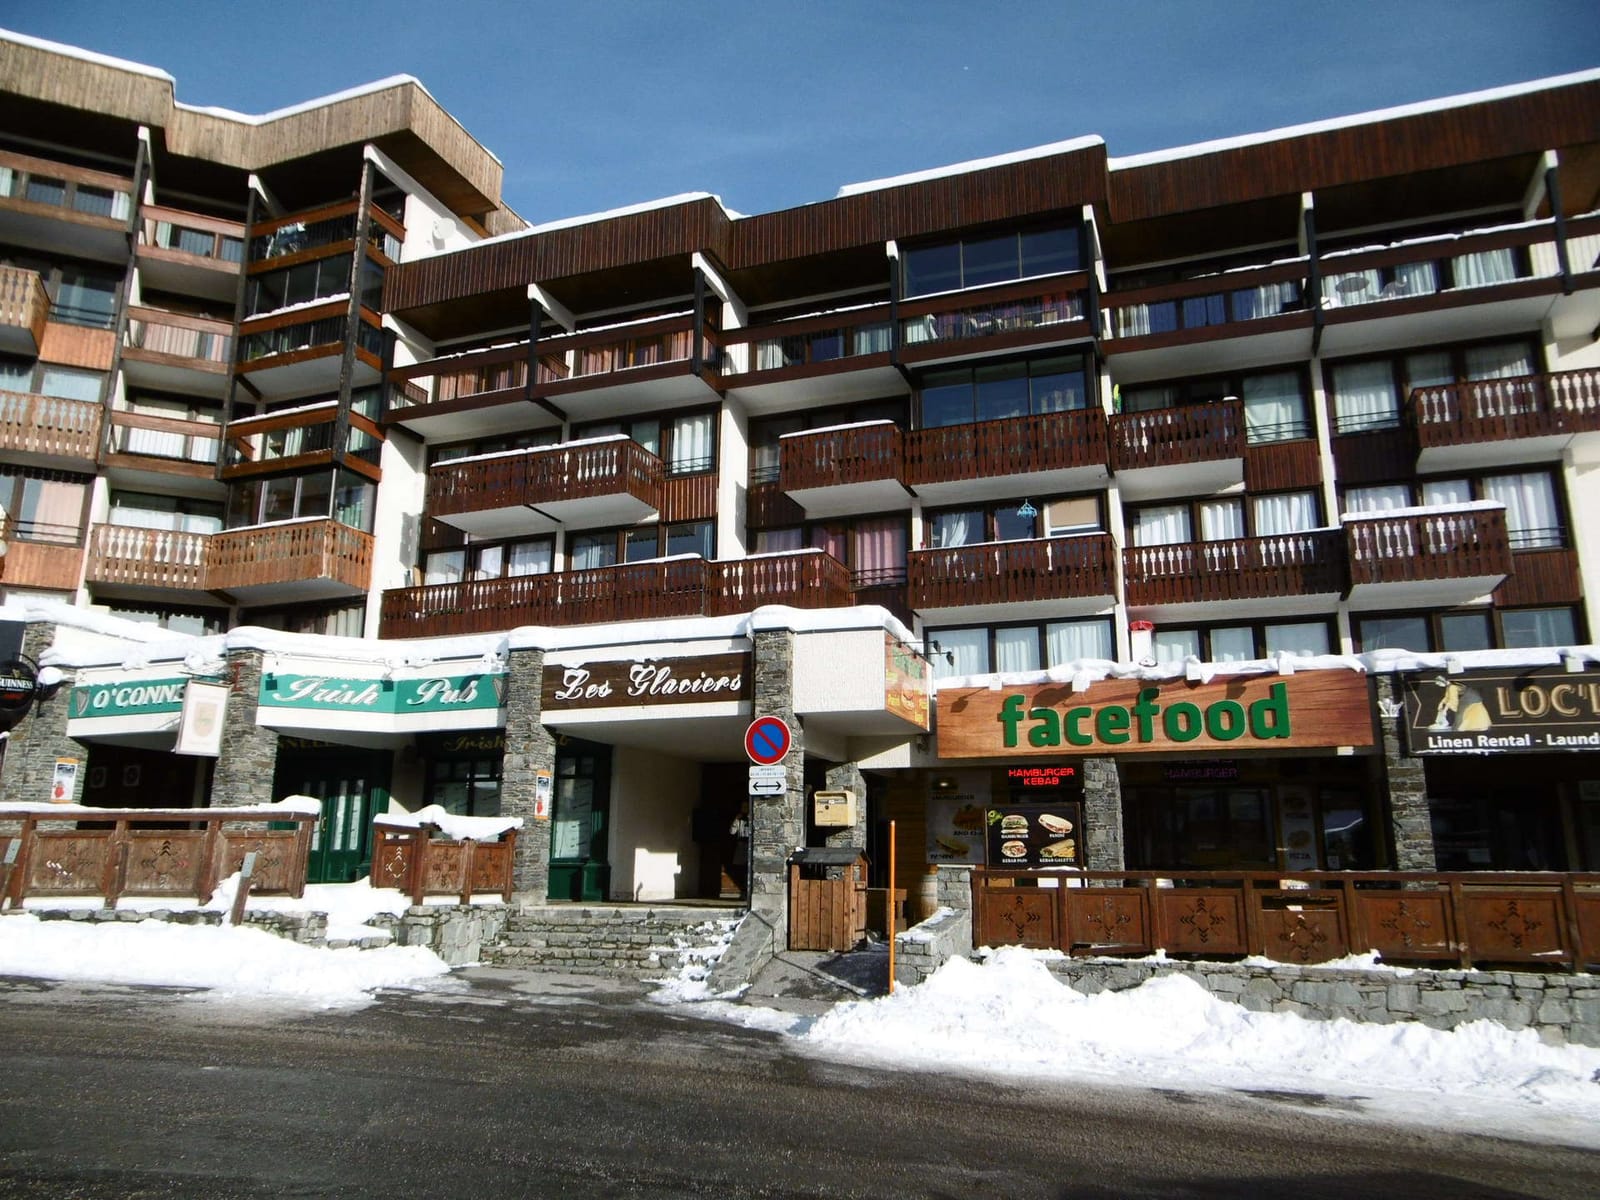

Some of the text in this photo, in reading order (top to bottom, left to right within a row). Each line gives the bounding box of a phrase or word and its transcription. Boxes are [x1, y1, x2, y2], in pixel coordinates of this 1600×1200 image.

[272, 678, 479, 706] Irish Pub
[555, 664, 742, 700] Les Glaciers
[998, 682, 1292, 749] facefood
[1428, 736, 1473, 749] Linen
[1477, 733, 1531, 748] Rental
[1008, 767, 1075, 777] HAMBURGER
[1023, 777, 1059, 786] KEBAB
